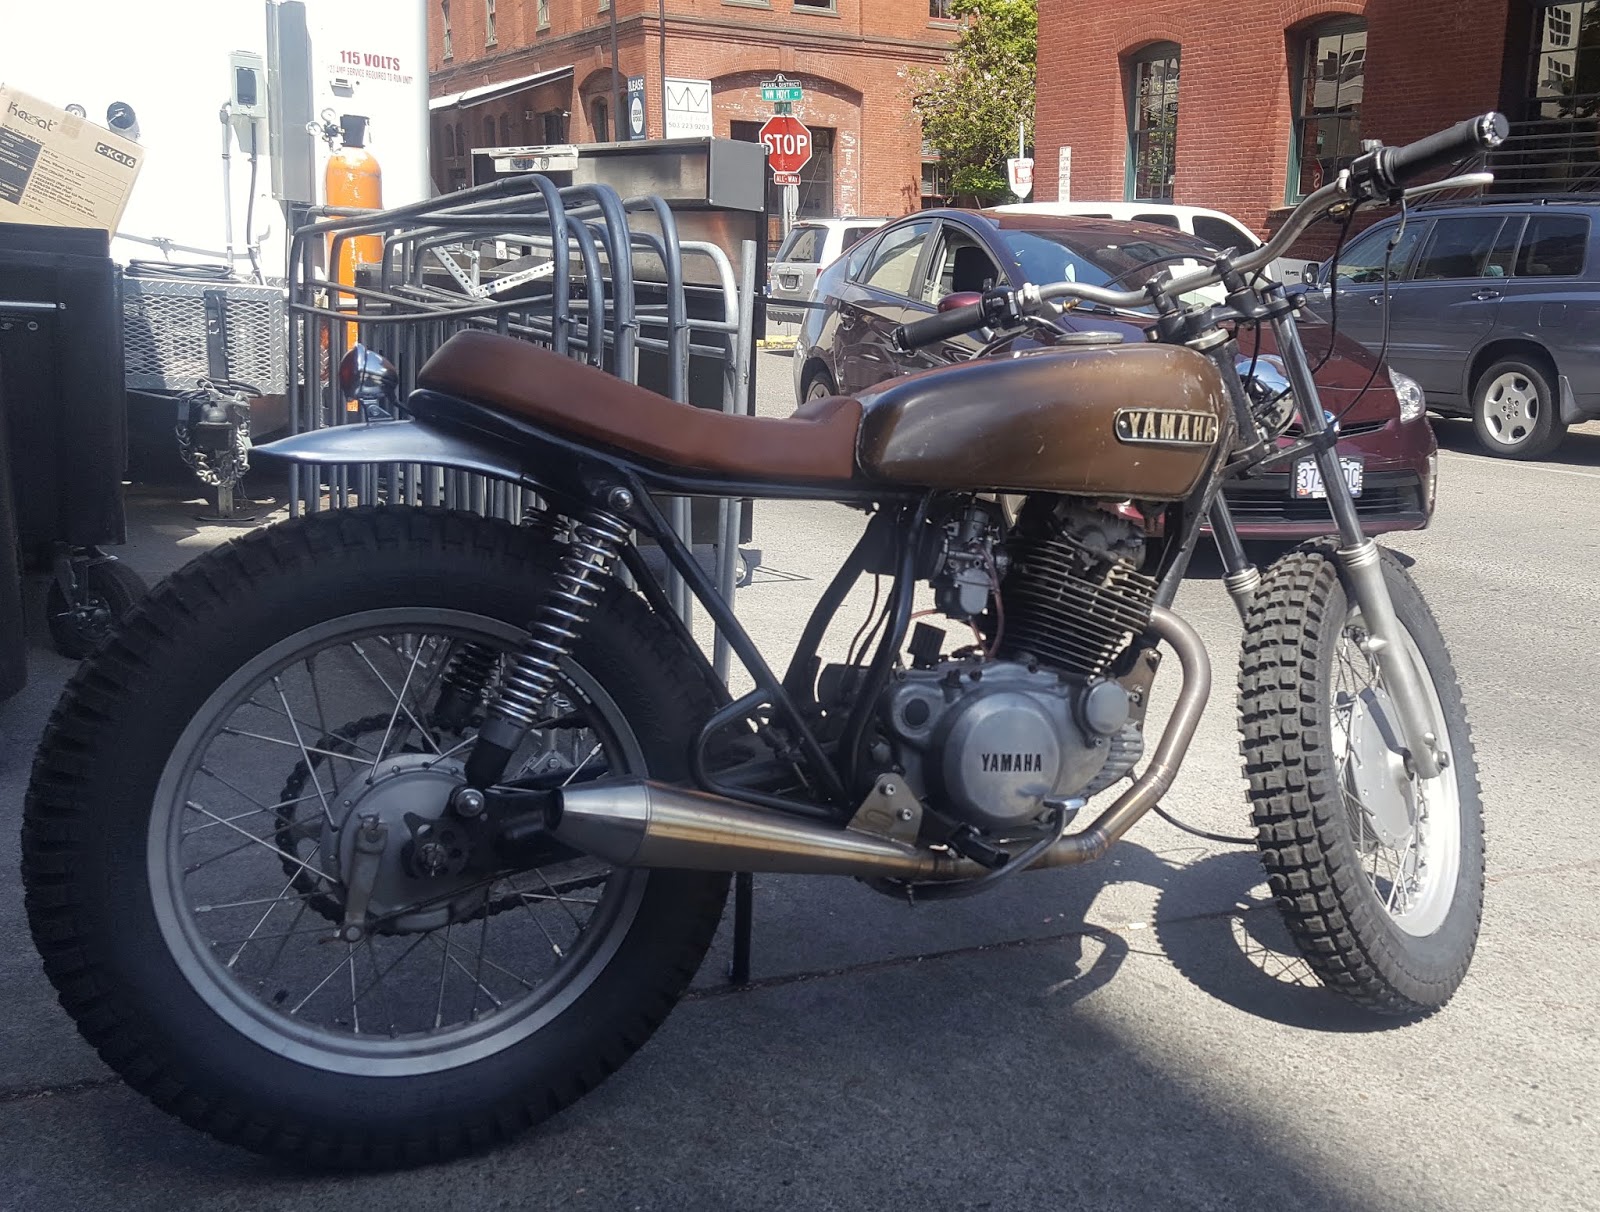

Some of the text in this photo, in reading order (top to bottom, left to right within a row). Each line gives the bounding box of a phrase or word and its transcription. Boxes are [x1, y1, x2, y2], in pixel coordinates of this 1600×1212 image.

[340, 50, 400, 71] 115 VOLTS
[347, 68, 365, 78] SERVICE
[366, 70, 387, 81] REQUIRED
[765, 90, 774, 99] NW
[776, 90, 790, 99] HOYT
[764, 134, 807, 154] STOP
[97, 144, 134, 167] C-KC16
[1128, 412, 1214, 442] YAMAHA
[981, 754, 1042, 772] YAMAHA
